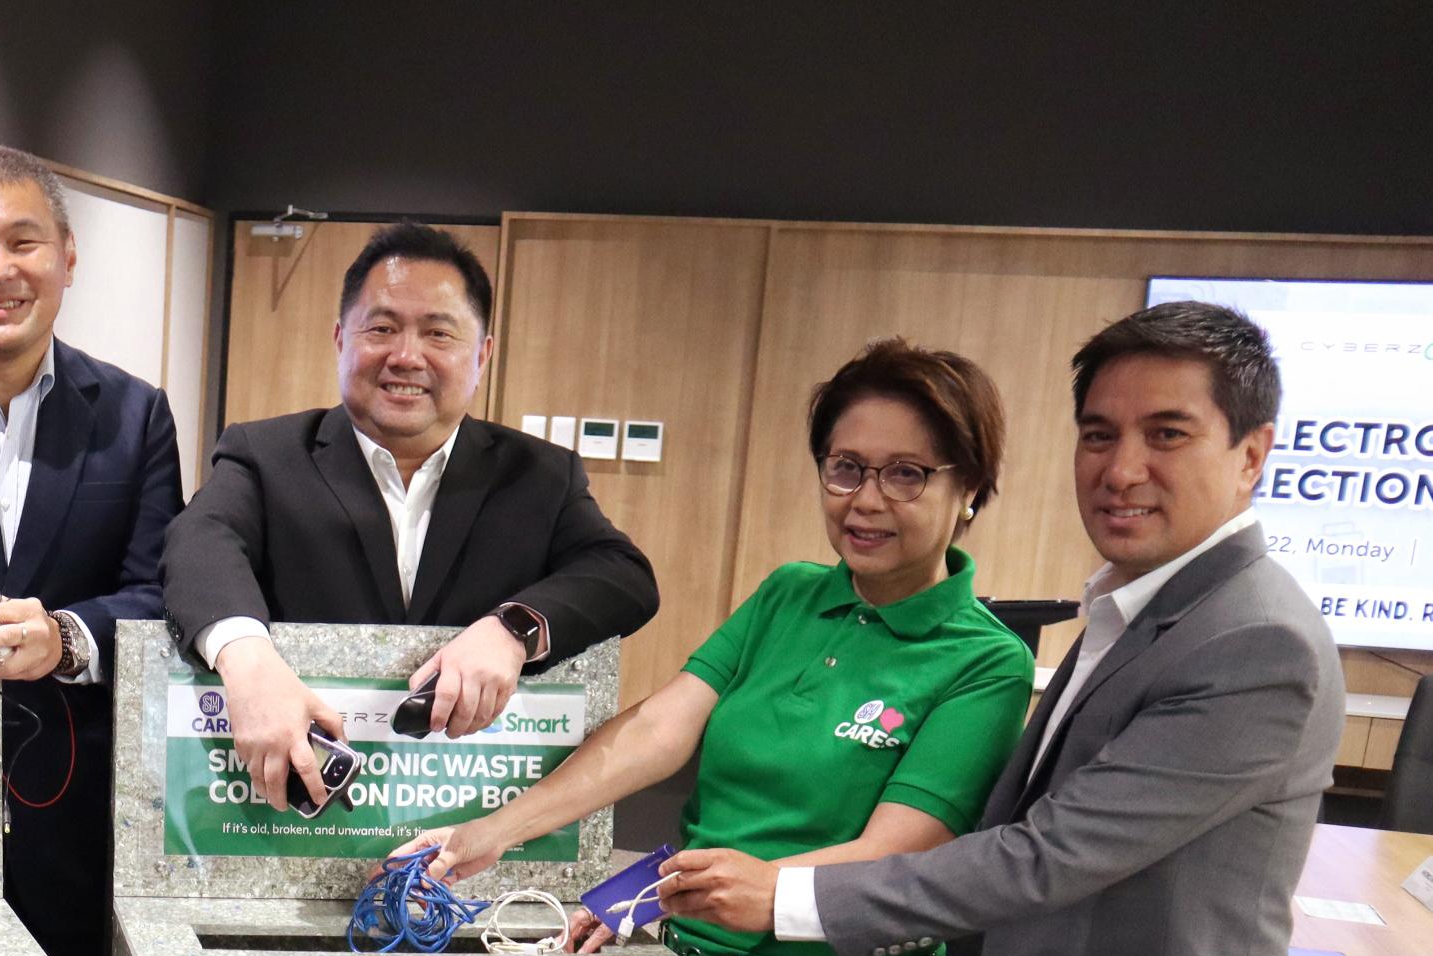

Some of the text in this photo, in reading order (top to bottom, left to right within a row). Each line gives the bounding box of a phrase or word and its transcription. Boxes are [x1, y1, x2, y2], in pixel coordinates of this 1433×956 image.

[1300, 341, 1433, 360] CYBERZ
[1255, 468, 1433, 505] ECTION
[1306, 538, 1394, 562] Monday
[1321, 597, 1348, 616] BE
[1355, 600, 1413, 621] KIND.
[192, 718, 232, 733] CAR
[505, 712, 570, 734] Smart
[443, 754, 543, 779] WASTE
[395, 783, 477, 808] DROP
[481, 786, 531, 809] BO
[222, 823, 231, 833] If
[232, 823, 248, 833] it's
[250, 823, 270, 835] old,
[272, 824, 312, 836] broken,
[314, 824, 336, 835] and
[338, 825, 395, 838] unwanted,
[397, 826, 412, 837] it's
